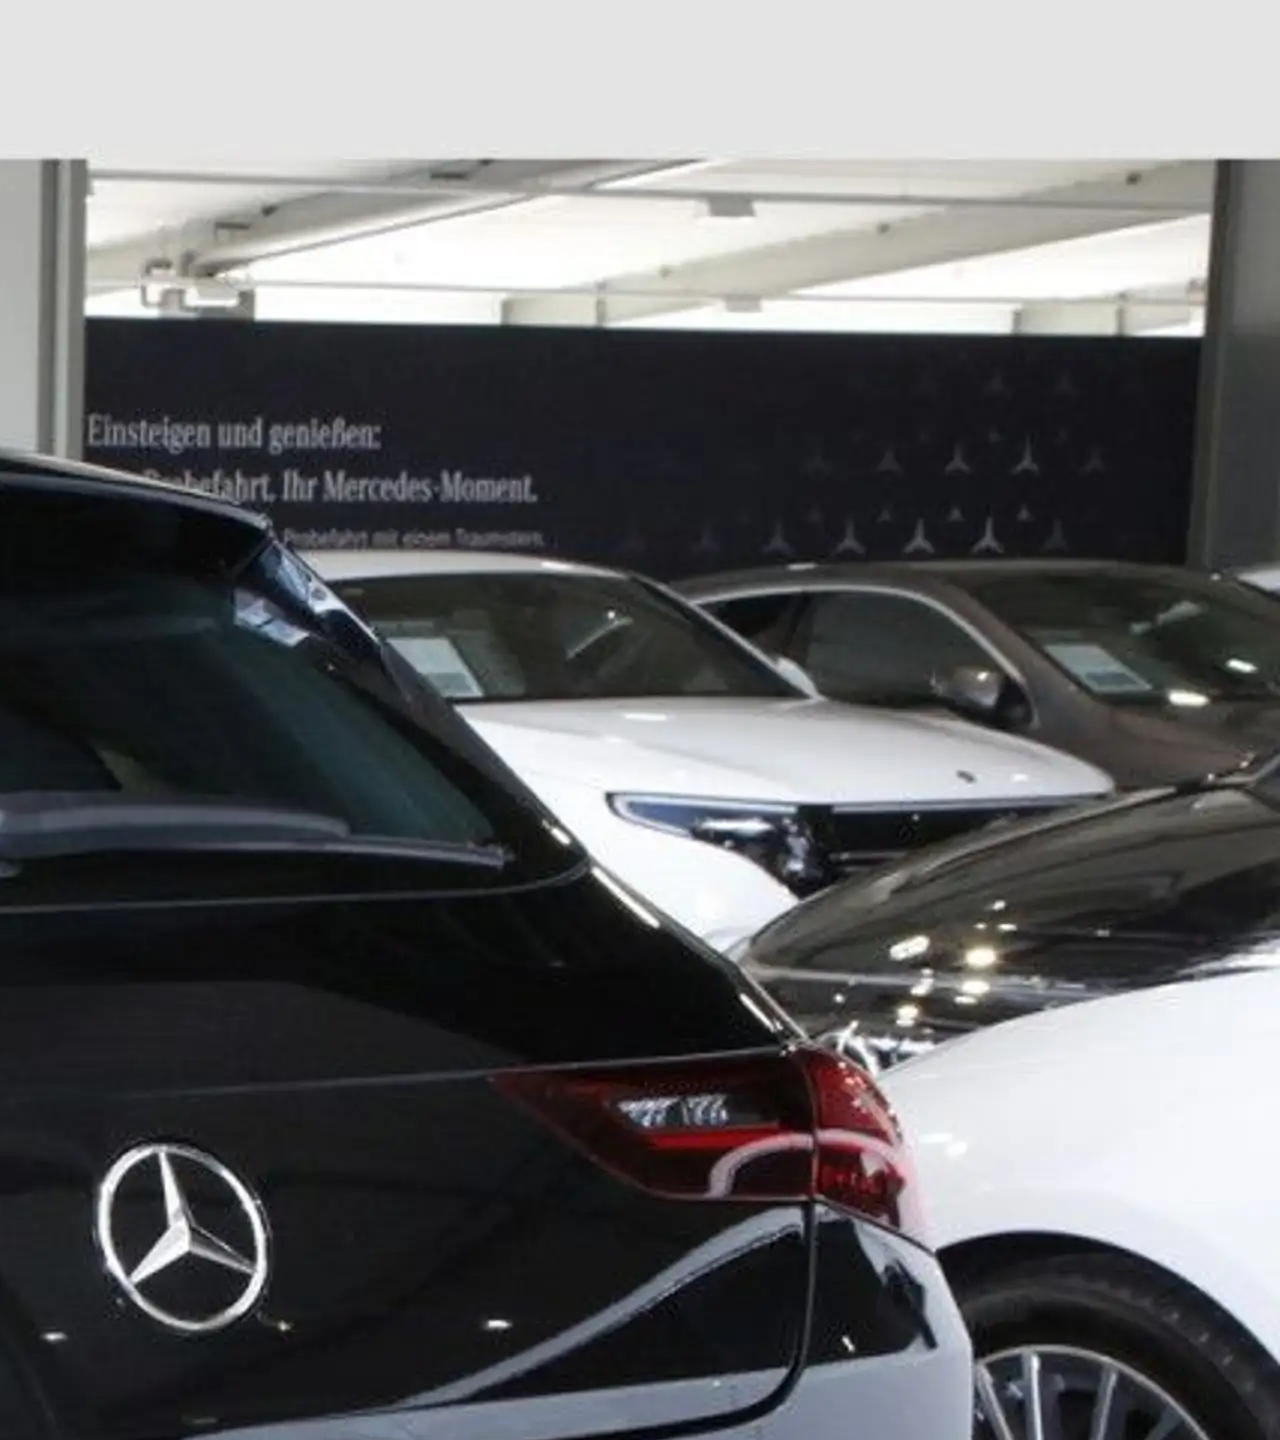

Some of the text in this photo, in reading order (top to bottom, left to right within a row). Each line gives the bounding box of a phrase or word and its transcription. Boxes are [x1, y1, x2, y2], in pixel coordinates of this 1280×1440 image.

[88, 413, 381, 454] Einsteigen und genießen:
[283, 469, 317, 501] Ihr
[322, 469, 539, 503] Mercedes-Moment.
